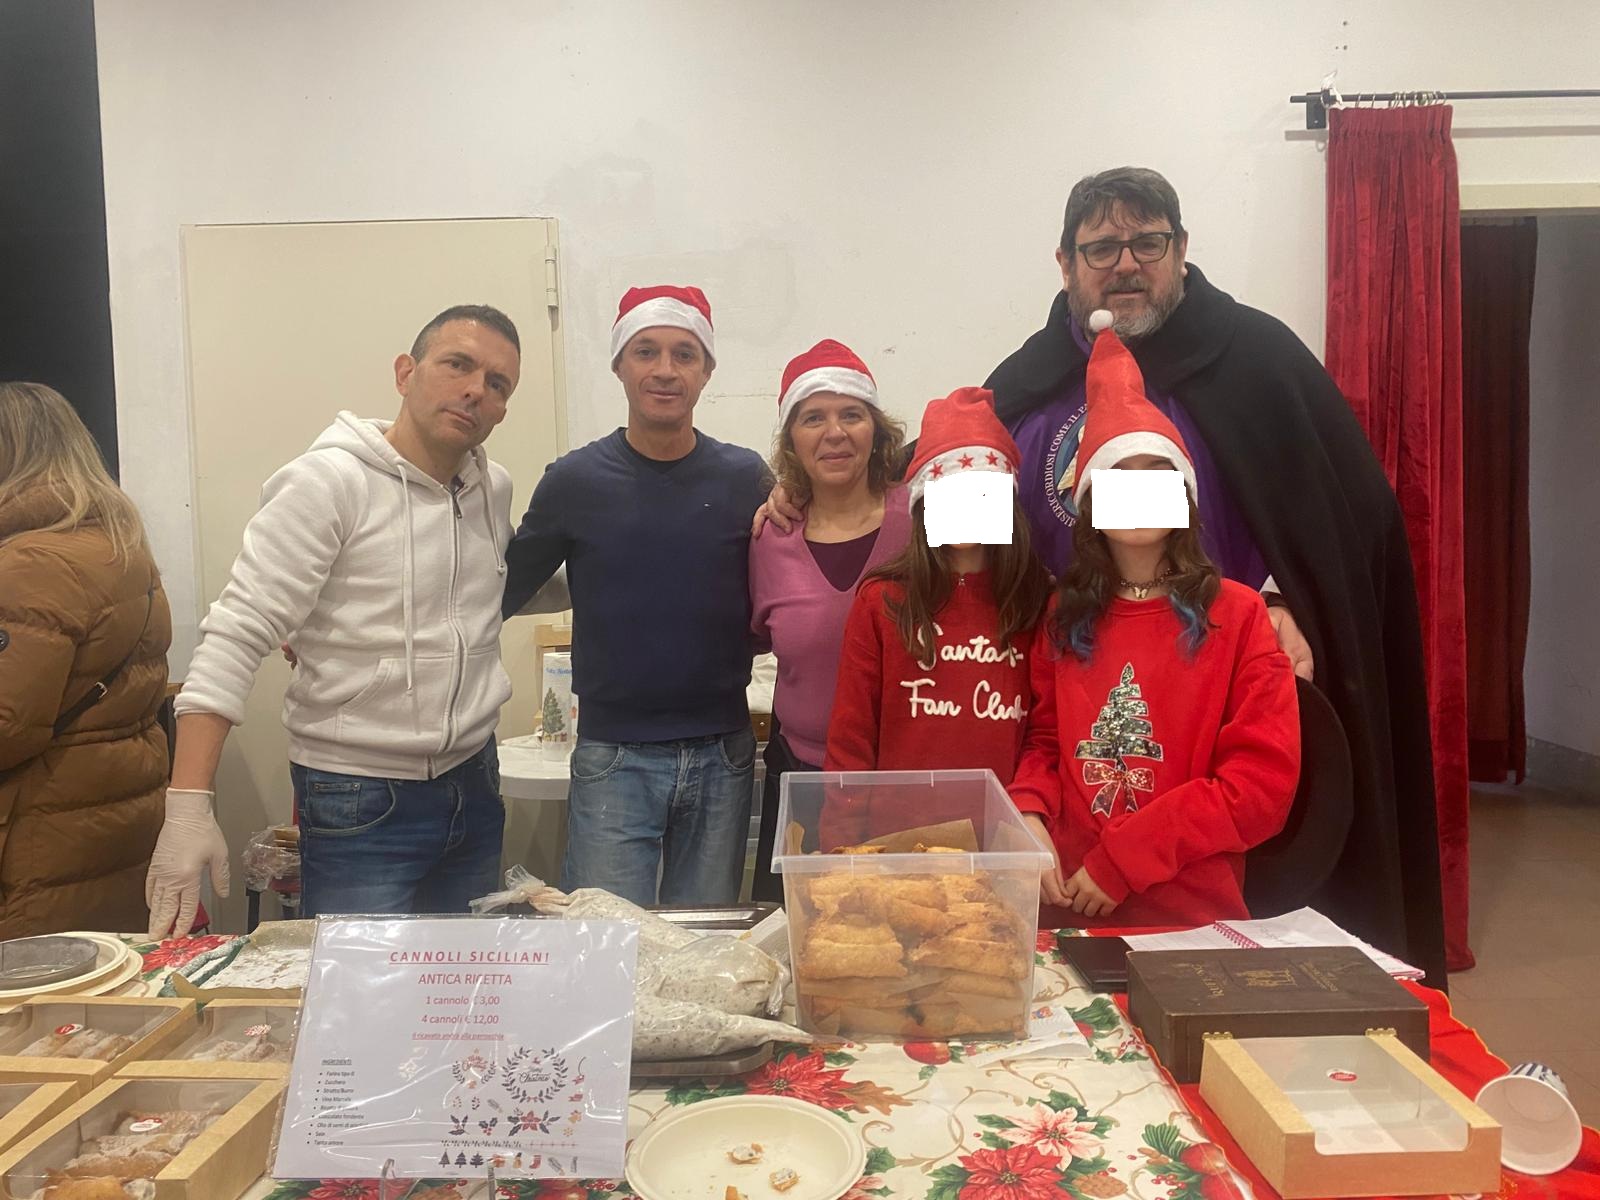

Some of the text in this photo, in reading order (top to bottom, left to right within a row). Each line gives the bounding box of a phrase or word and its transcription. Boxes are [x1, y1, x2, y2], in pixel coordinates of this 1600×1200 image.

[1050, 423, 1072, 452] COME
[1067, 414, 1081, 424] IL
[900, 678, 1028, 722] Fan Club
[390, 951, 550, 964] CANNOLI SICILIANI
[418, 974, 512, 985] ANTICA RICETTA
[426, 996, 431, 1005] 1
[433, 996, 470, 1005] cannolo
[479, 996, 500, 1006] 3,00
[421, 1015, 428, 1024] 4
[429, 1015, 463, 1024] cannoli
[473, 1015, 499, 1026] 12,00
